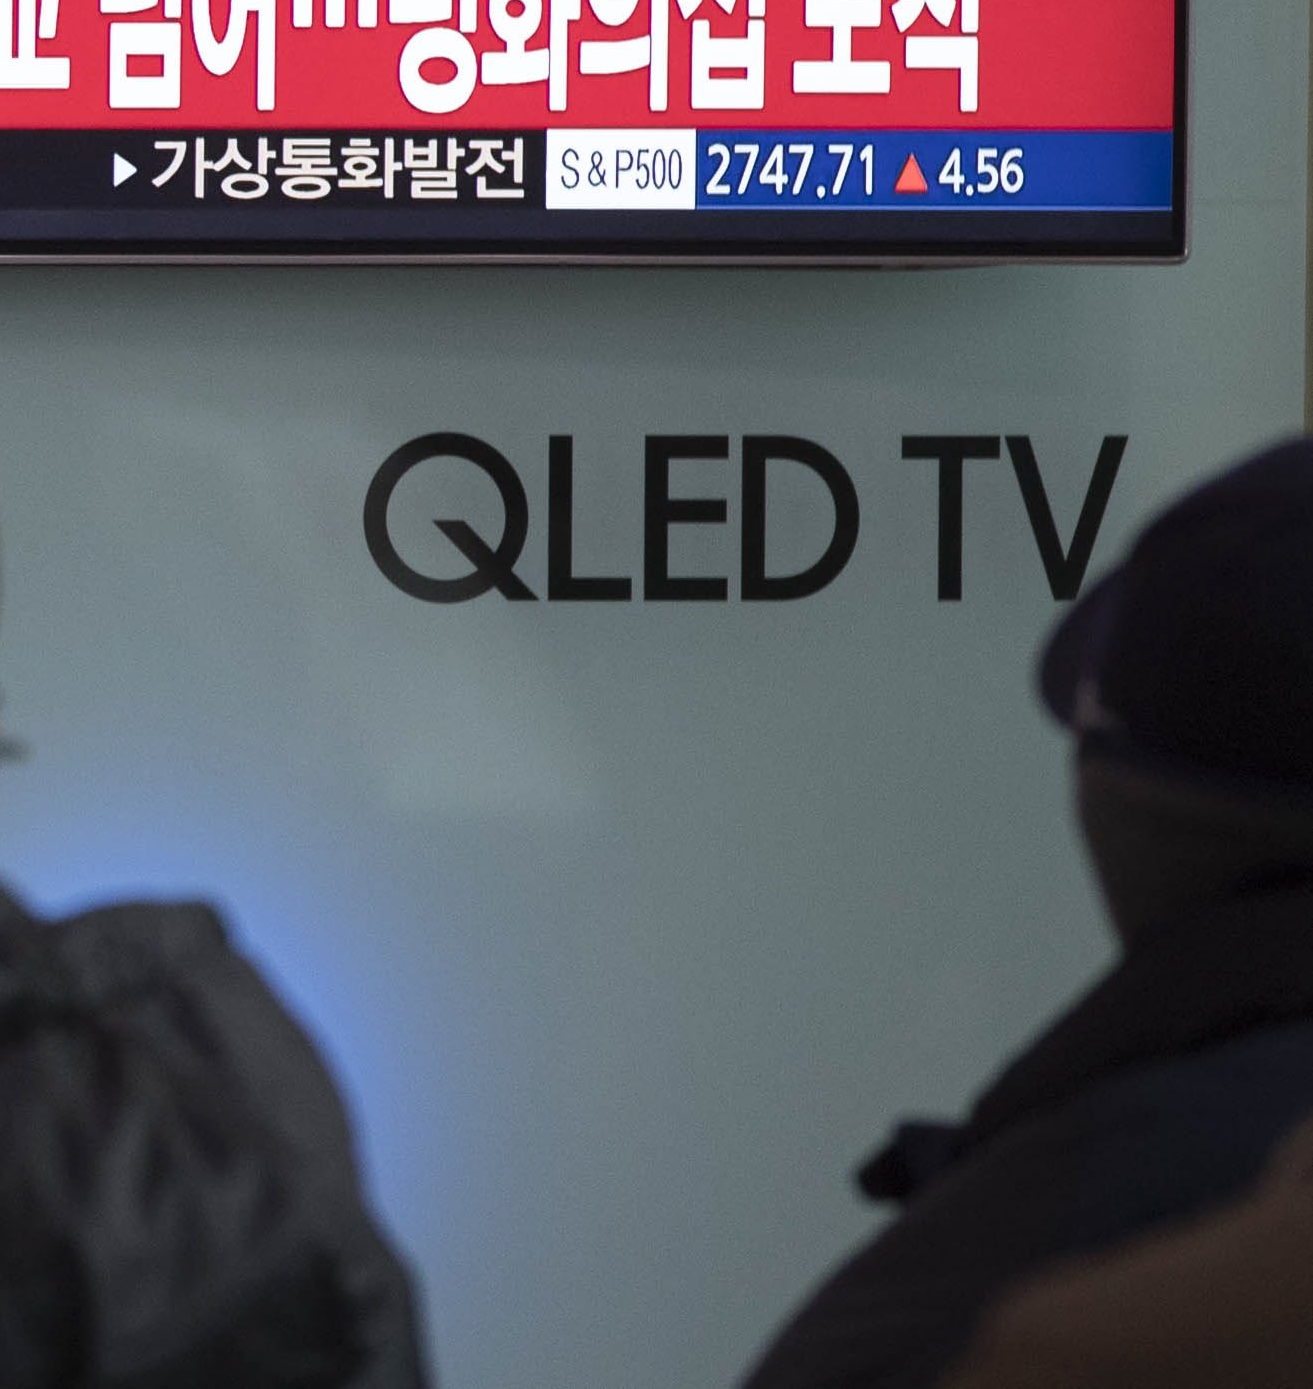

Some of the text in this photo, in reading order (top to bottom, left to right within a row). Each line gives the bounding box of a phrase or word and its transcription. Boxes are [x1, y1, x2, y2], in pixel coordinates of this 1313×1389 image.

[151, 136, 526, 199] 가상통화발전
[705, 142, 876, 198] 2747.71
[937, 147, 1025, 196] 4.56
[362, 430, 1130, 604] QLED TV
